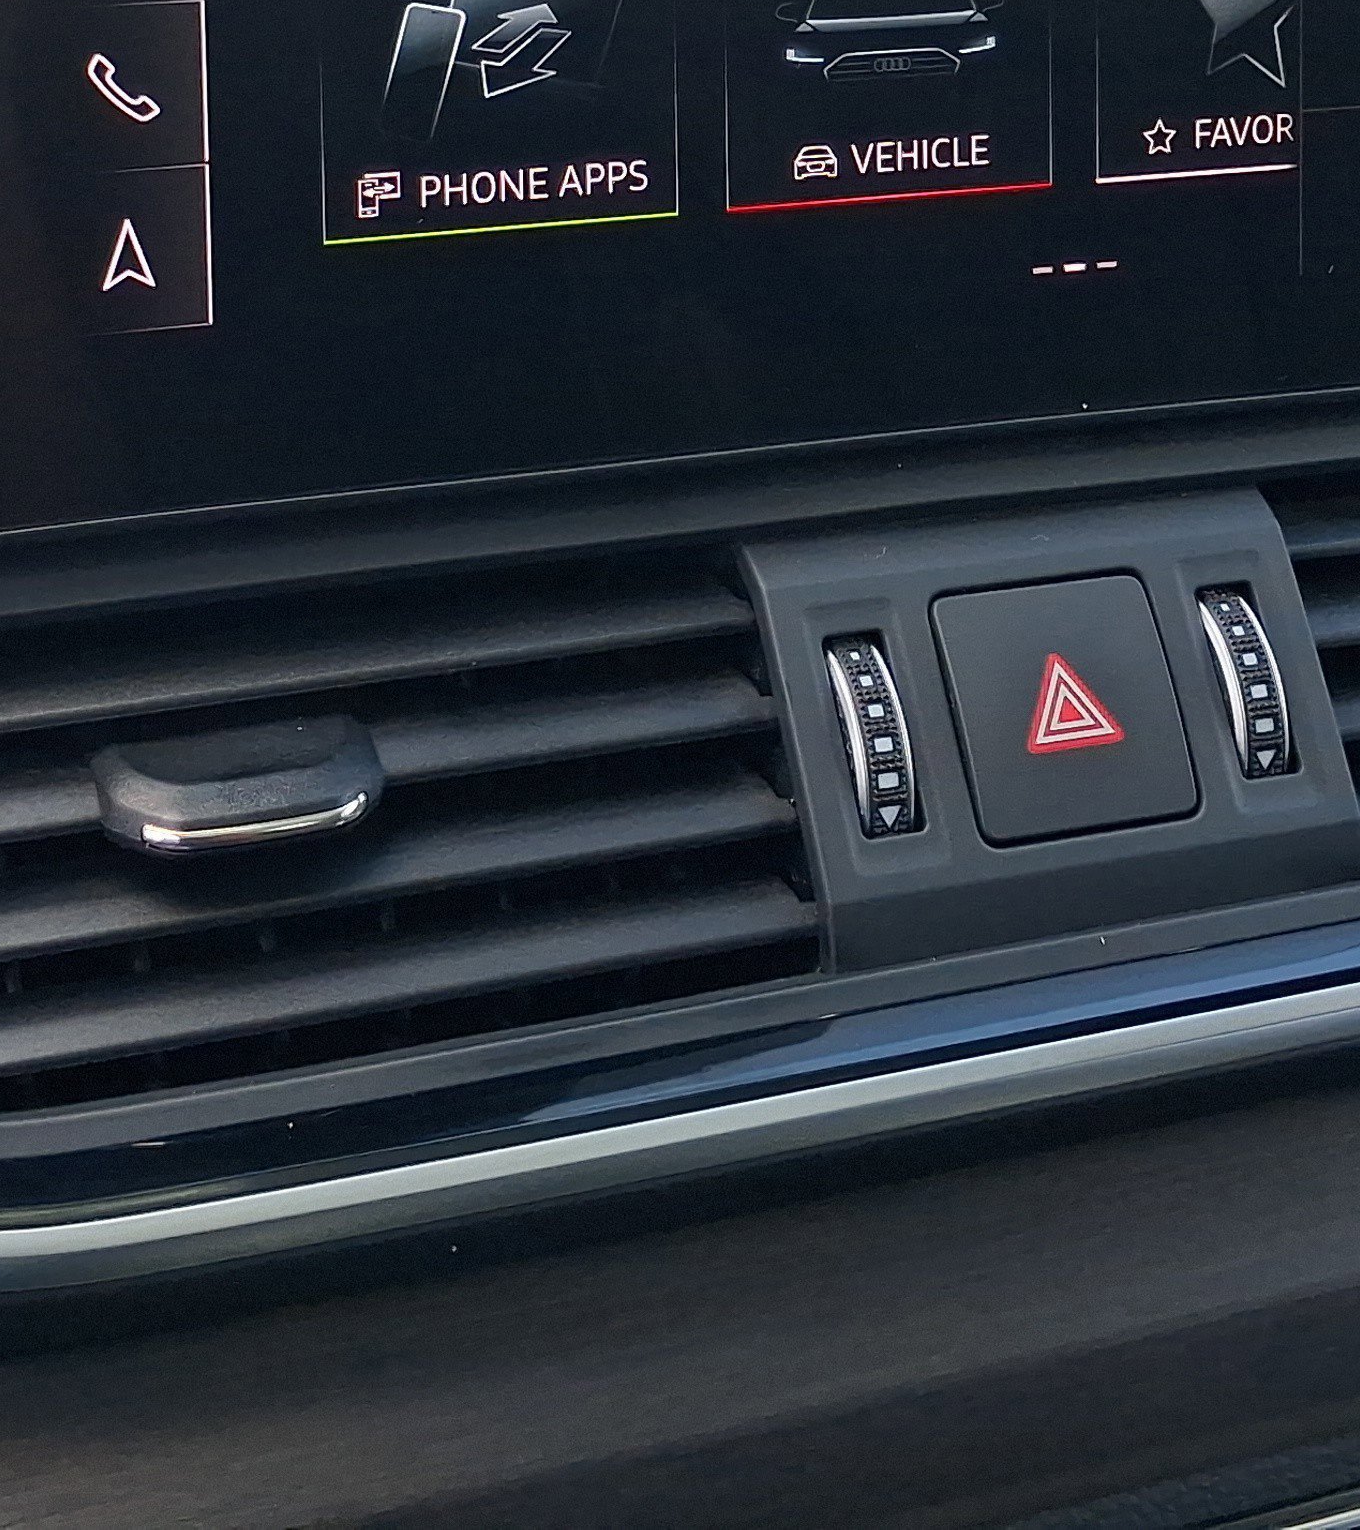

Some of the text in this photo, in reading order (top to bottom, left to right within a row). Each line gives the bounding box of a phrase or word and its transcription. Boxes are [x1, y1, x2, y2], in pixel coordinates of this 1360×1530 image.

[1194, 113, 1295, 150] FAVOR
[851, 134, 991, 174] VEHICLE
[420, 159, 649, 208] PHONE APPS
